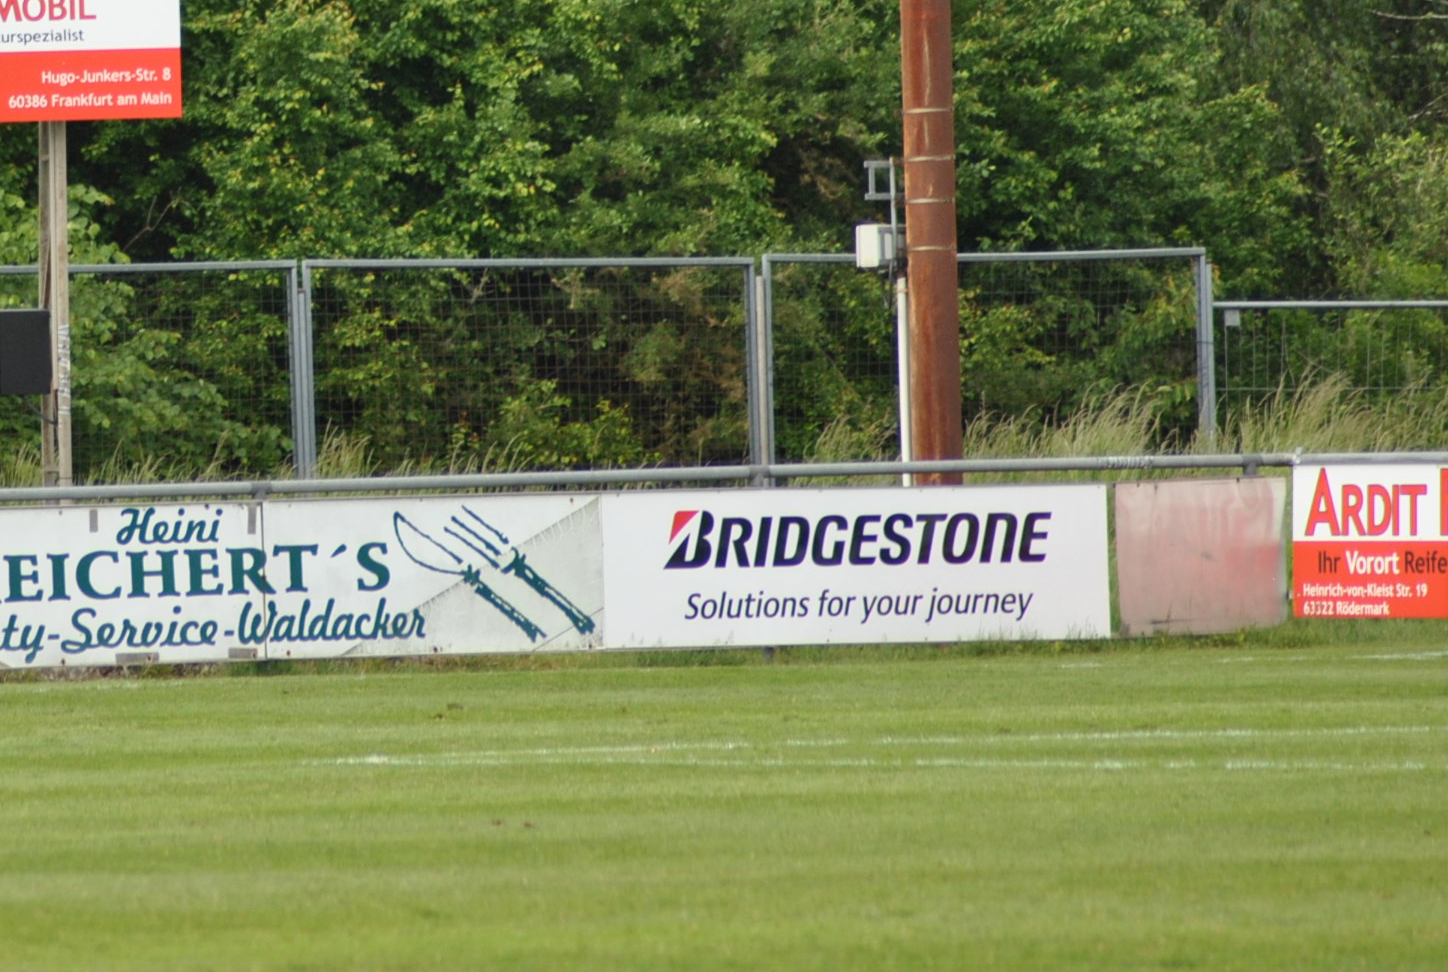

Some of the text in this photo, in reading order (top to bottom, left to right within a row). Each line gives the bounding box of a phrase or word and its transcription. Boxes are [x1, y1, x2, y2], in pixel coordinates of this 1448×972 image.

[41, 67, 171, 86] Hugo-Junkers-Str. 8
[8, 92, 172, 108] 60386 Frankfurt am Main
[1304, 468, 1427, 536] ARDIT
[116, 507, 224, 545] Heini
[663, 509, 1052, 570] BRIDGESTONE
[1318, 551, 1340, 573] Ihr
[1345, 550, 1400, 574] Vorort
[1303, 583, 1427, 597] Heinrich-von-Kleist Str. 19
[684, 587, 1034, 624] Solutions for your journey
[1303, 601, 1389, 615] 63322 Rödermark
